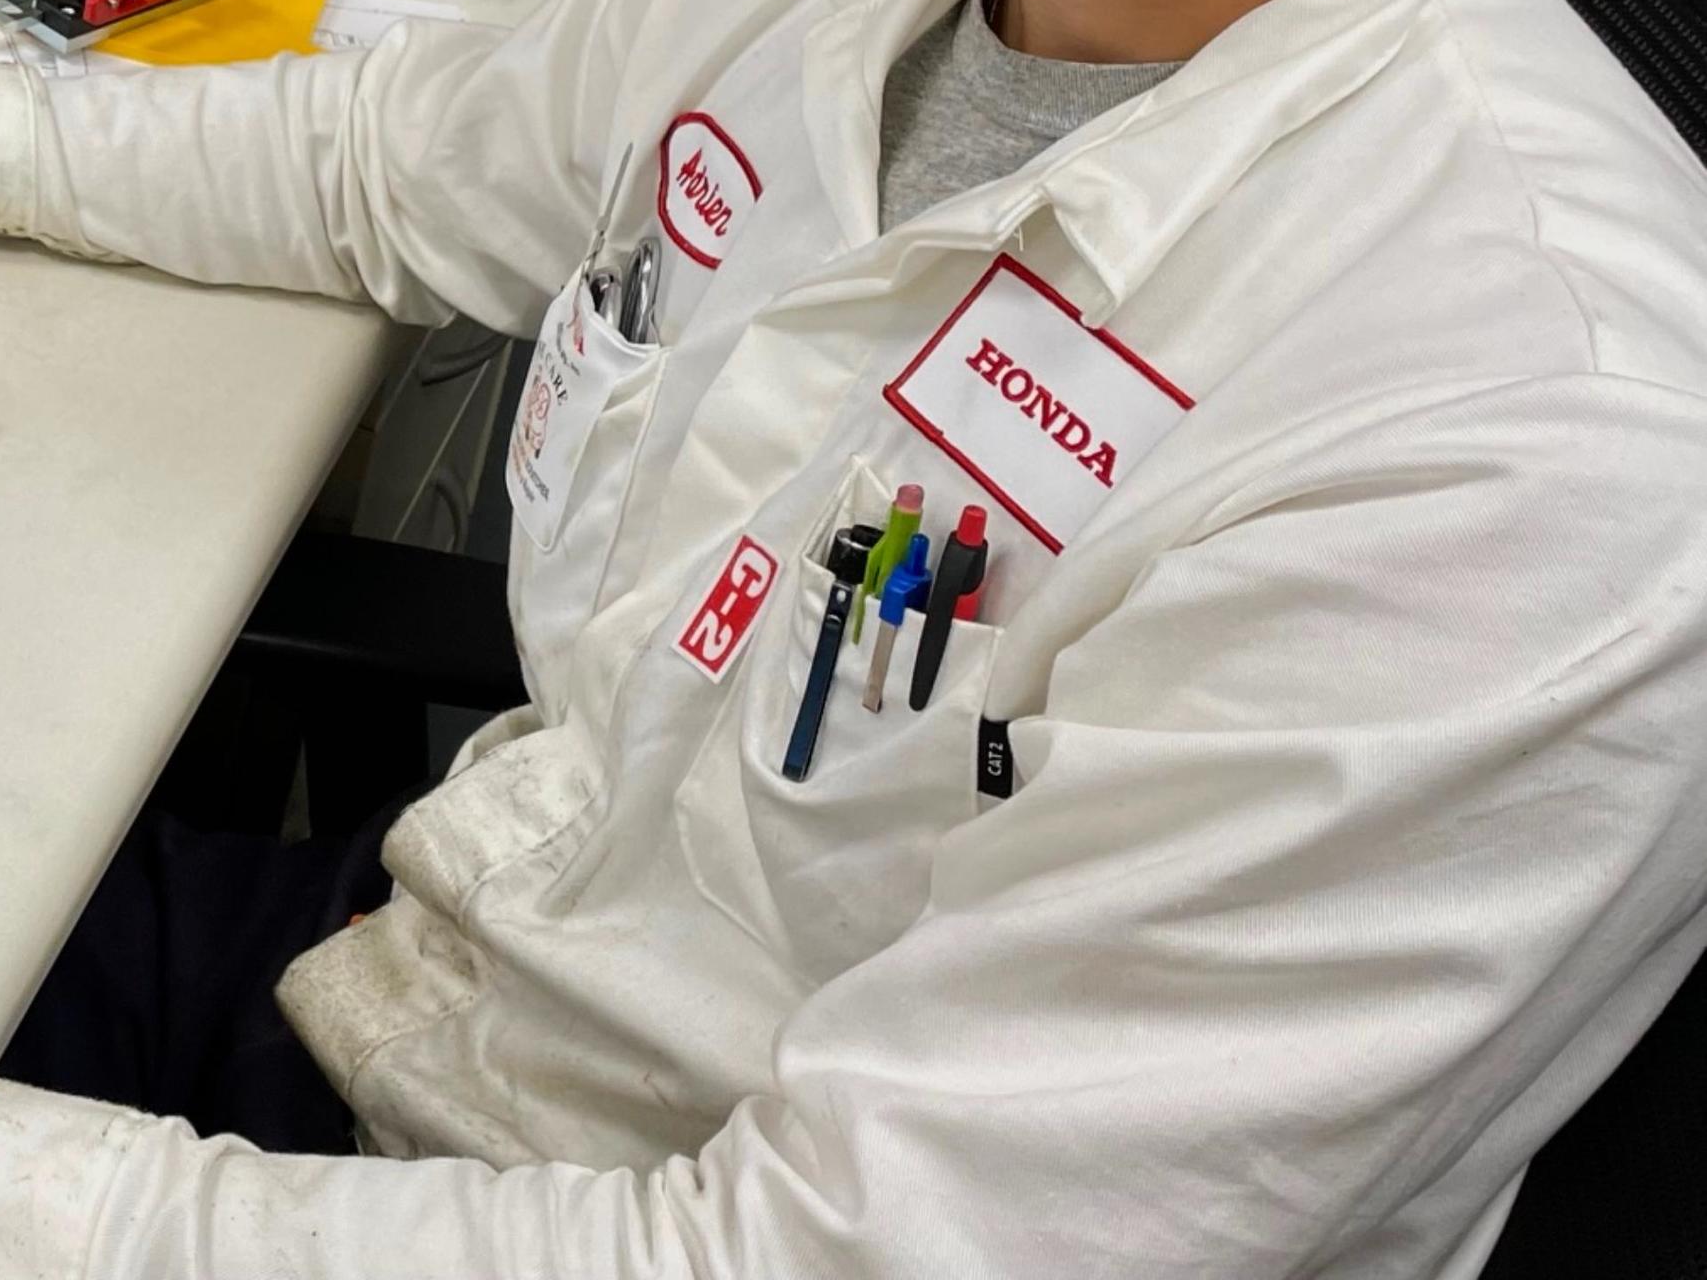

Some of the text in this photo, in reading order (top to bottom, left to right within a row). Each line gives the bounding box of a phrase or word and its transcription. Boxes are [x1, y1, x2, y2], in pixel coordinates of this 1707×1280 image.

[676, 147, 733, 238] Adrien
[965, 337, 1118, 490] HONDA
[688, 546, 772, 661] C-2
[987, 742, 1004, 777] CAT 2
